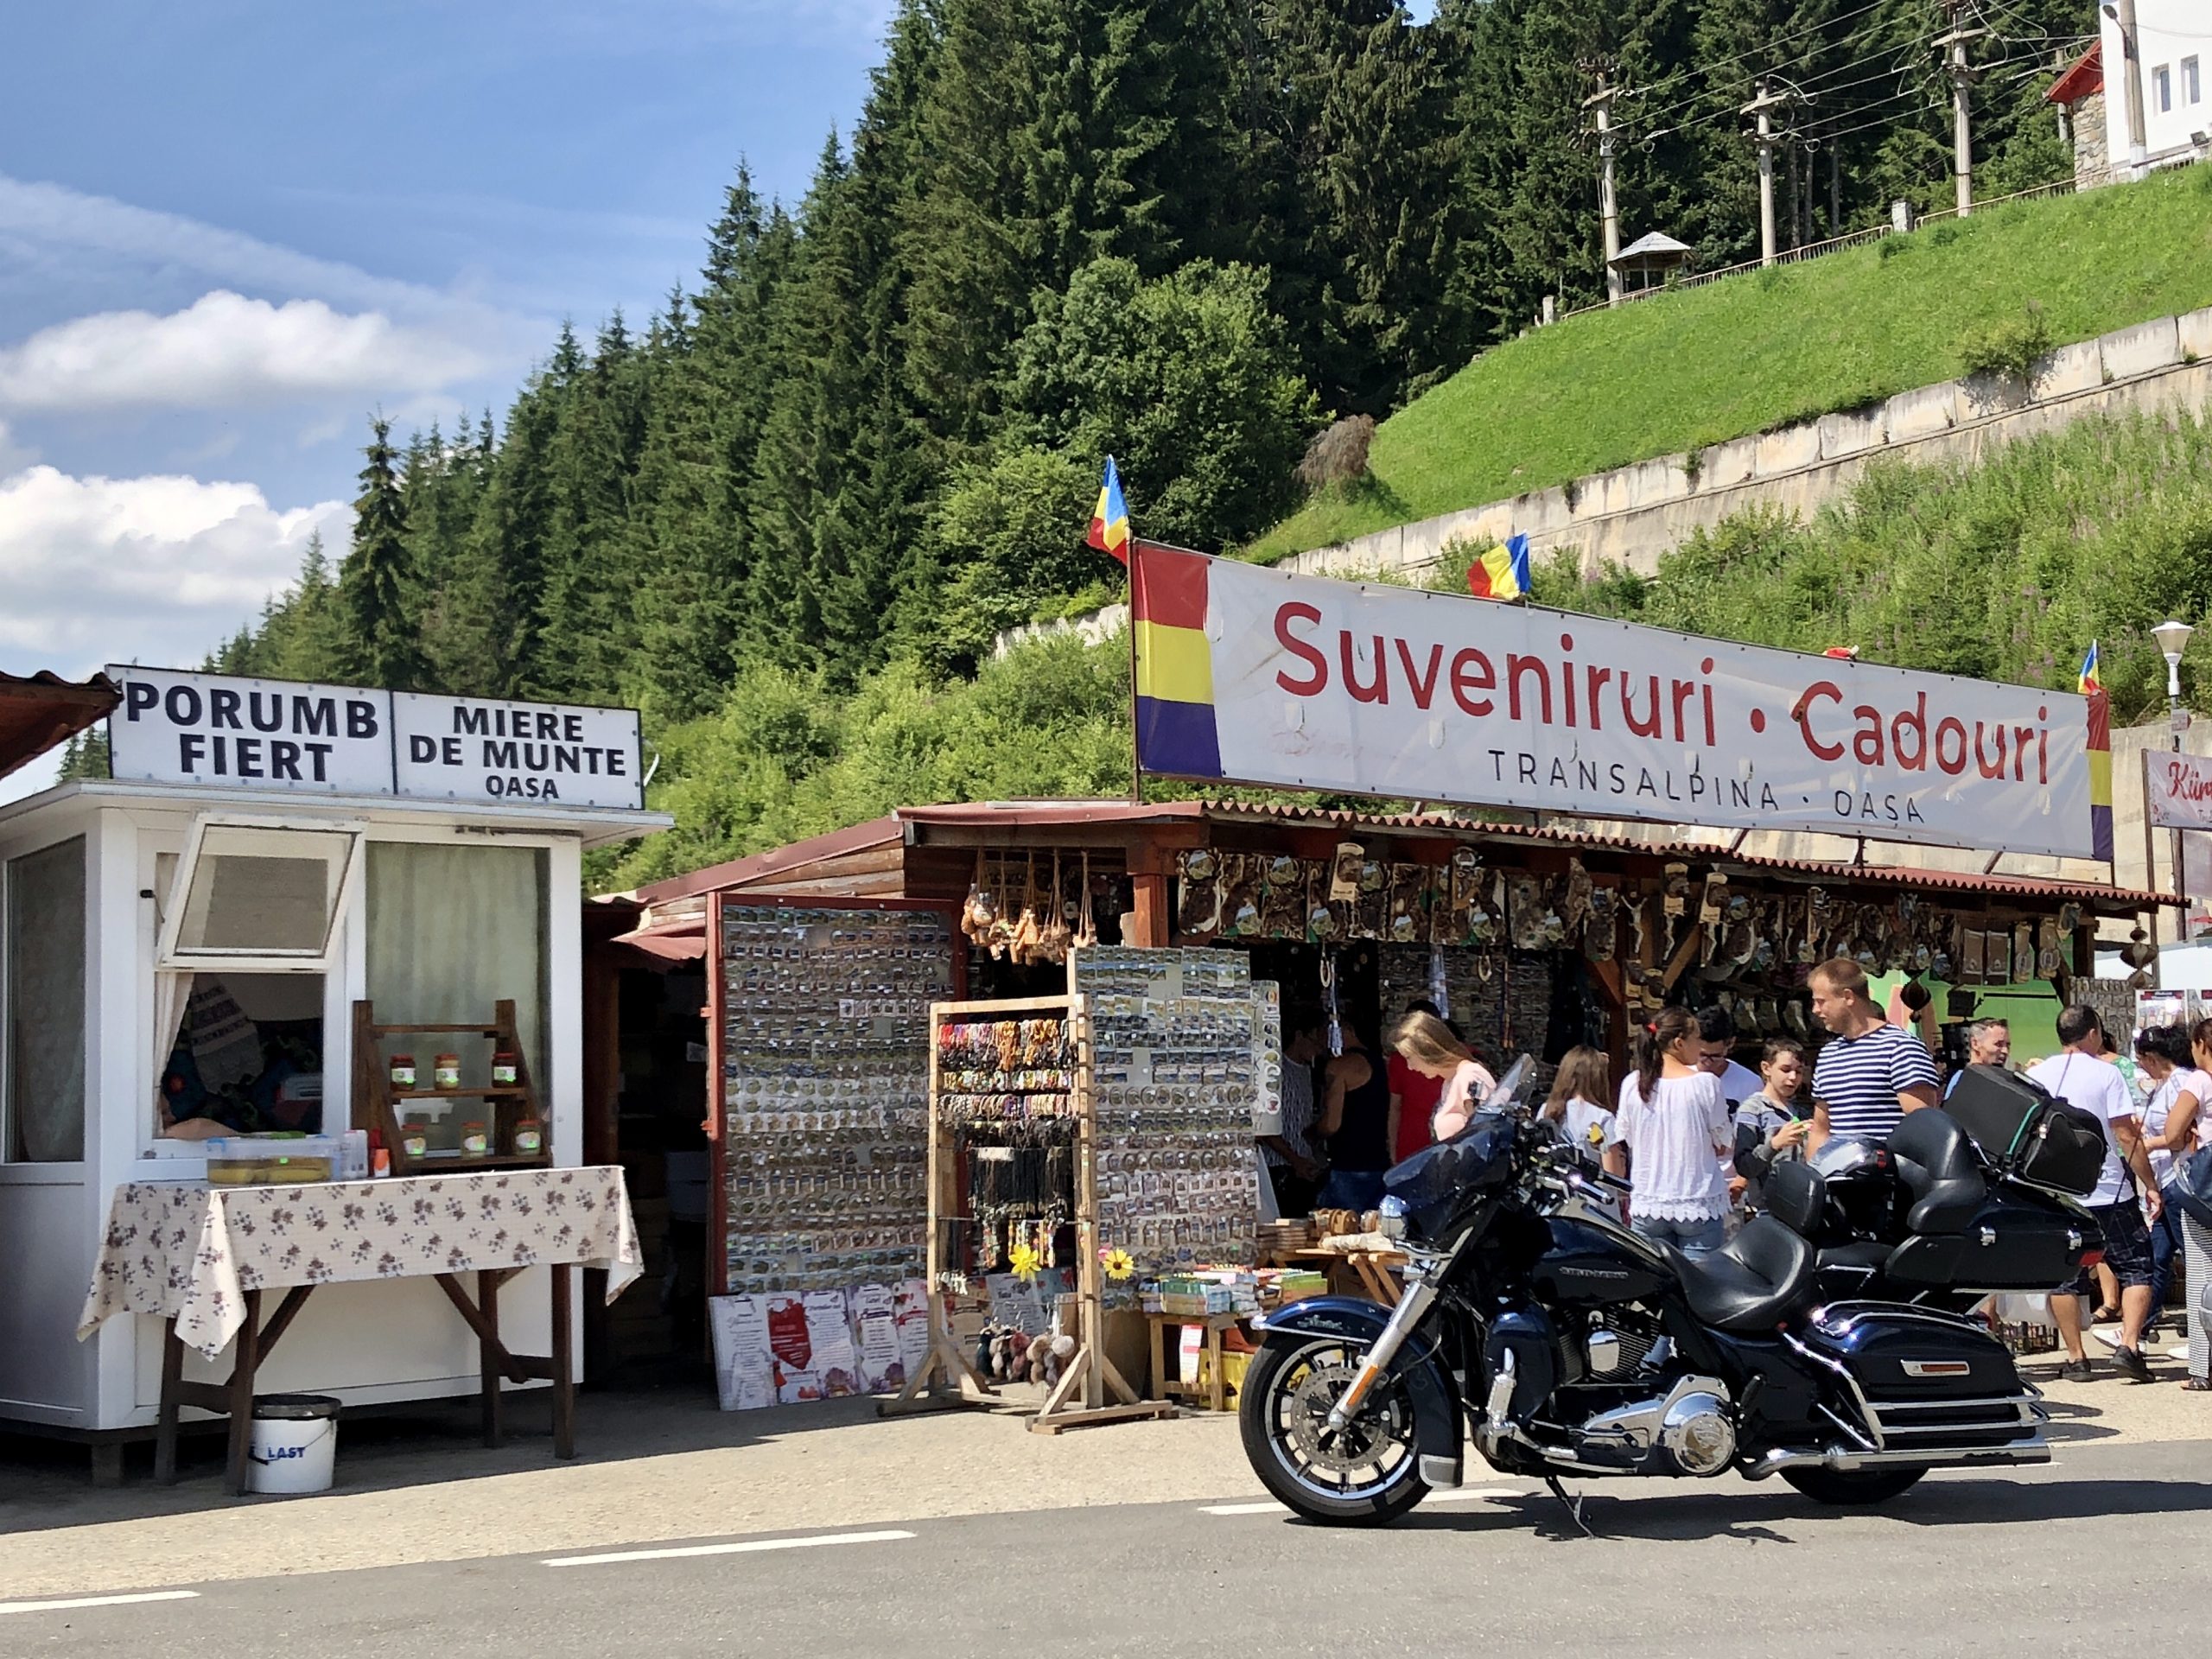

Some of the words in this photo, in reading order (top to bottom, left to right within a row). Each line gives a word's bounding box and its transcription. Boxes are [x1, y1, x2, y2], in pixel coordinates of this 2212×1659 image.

[126, 682, 378, 740] PORUMB
[1274, 601, 1716, 747] Suveniruri
[1791, 681, 2048, 784] Cadouri
[454, 706, 584, 743] MIERE
[180, 734, 334, 782] FIERT
[410, 734, 462, 766] DE
[483, 740, 626, 776] MUNTE
[486, 775, 560, 799] OASA
[1488, 749, 1779, 810] TRANSALPINA
